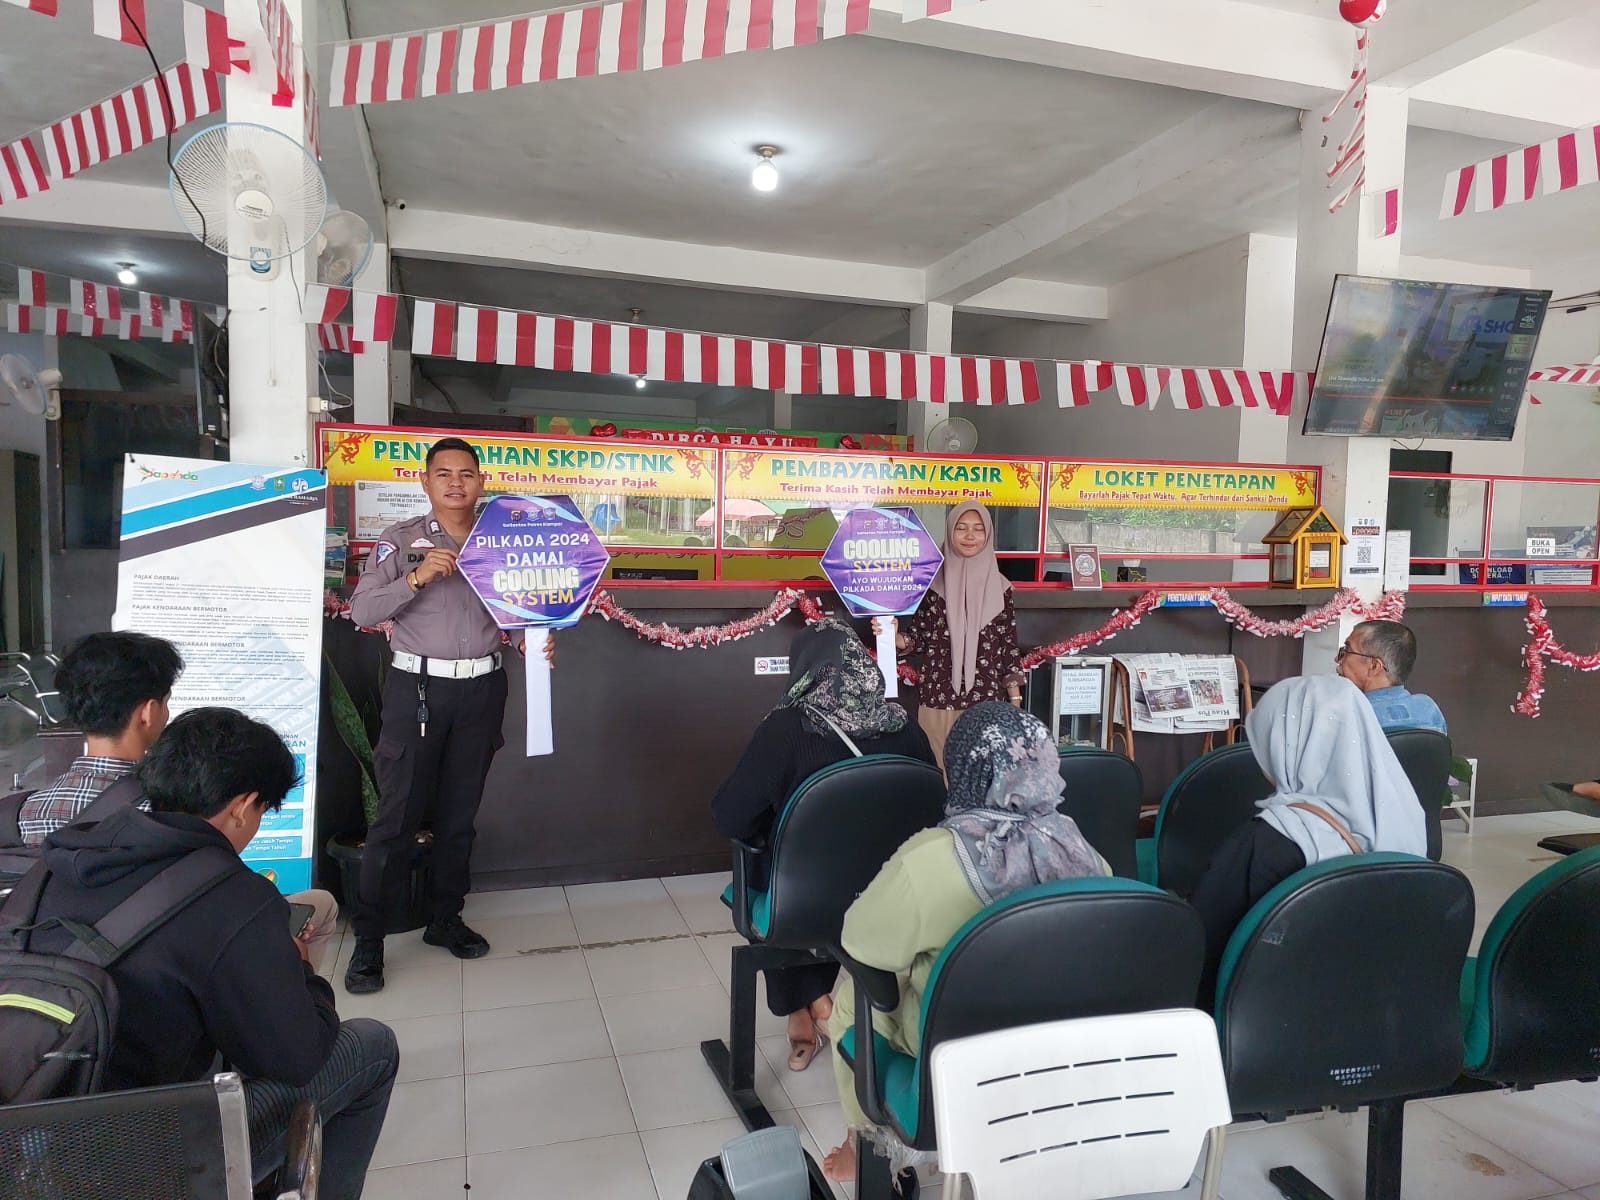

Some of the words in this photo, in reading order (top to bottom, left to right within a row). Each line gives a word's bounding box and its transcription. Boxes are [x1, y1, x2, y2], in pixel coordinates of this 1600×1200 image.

[374, 440, 540, 467] PENAHAN
[547, 448, 674, 473] SKPD/STNK
[771, 458, 1003, 483] PEMBAYARAN/KASIR
[498, 471, 537, 483] Telah
[542, 473, 617, 488] Membayar
[622, 477, 658, 490] Pajak
[1095, 470, 1159, 487] LOKET
[1165, 472, 1276, 490] PENETAPAN
[780, 482, 822, 493] Terima
[825, 484, 859, 495] Kasih
[863, 485, 894, 496] Telah
[898, 486, 959, 499] Membayar
[962, 488, 993, 499] Pajak
[1079, 490, 1110, 500] Bayarlah
[1112, 491, 1130, 501] Pajak
[1132, 491, 1151, 501] Tepat
[1181, 493, 1197, 503] Agar
[1199, 493, 1230, 502] Terhindar
[1246, 495, 1267, 503] Sanksi
[476, 534, 545, 549] PILKADA
[549, 533, 590, 546] 2024
[843, 537, 920, 559] COOLING
[506, 551, 564, 567] DAMAI
[853, 559, 912, 572] SYSTEM
[492, 567, 580, 592] COOLING
[843, 585, 875, 593] PILKADA
[877, 584, 901, 592] DAMAI
[902, 583, 922, 591] 2024
[851, 576, 868, 584] AYO
[870, 575, 914, 584] WUJUDKAN
[502, 589, 574, 607] SYSTEM
